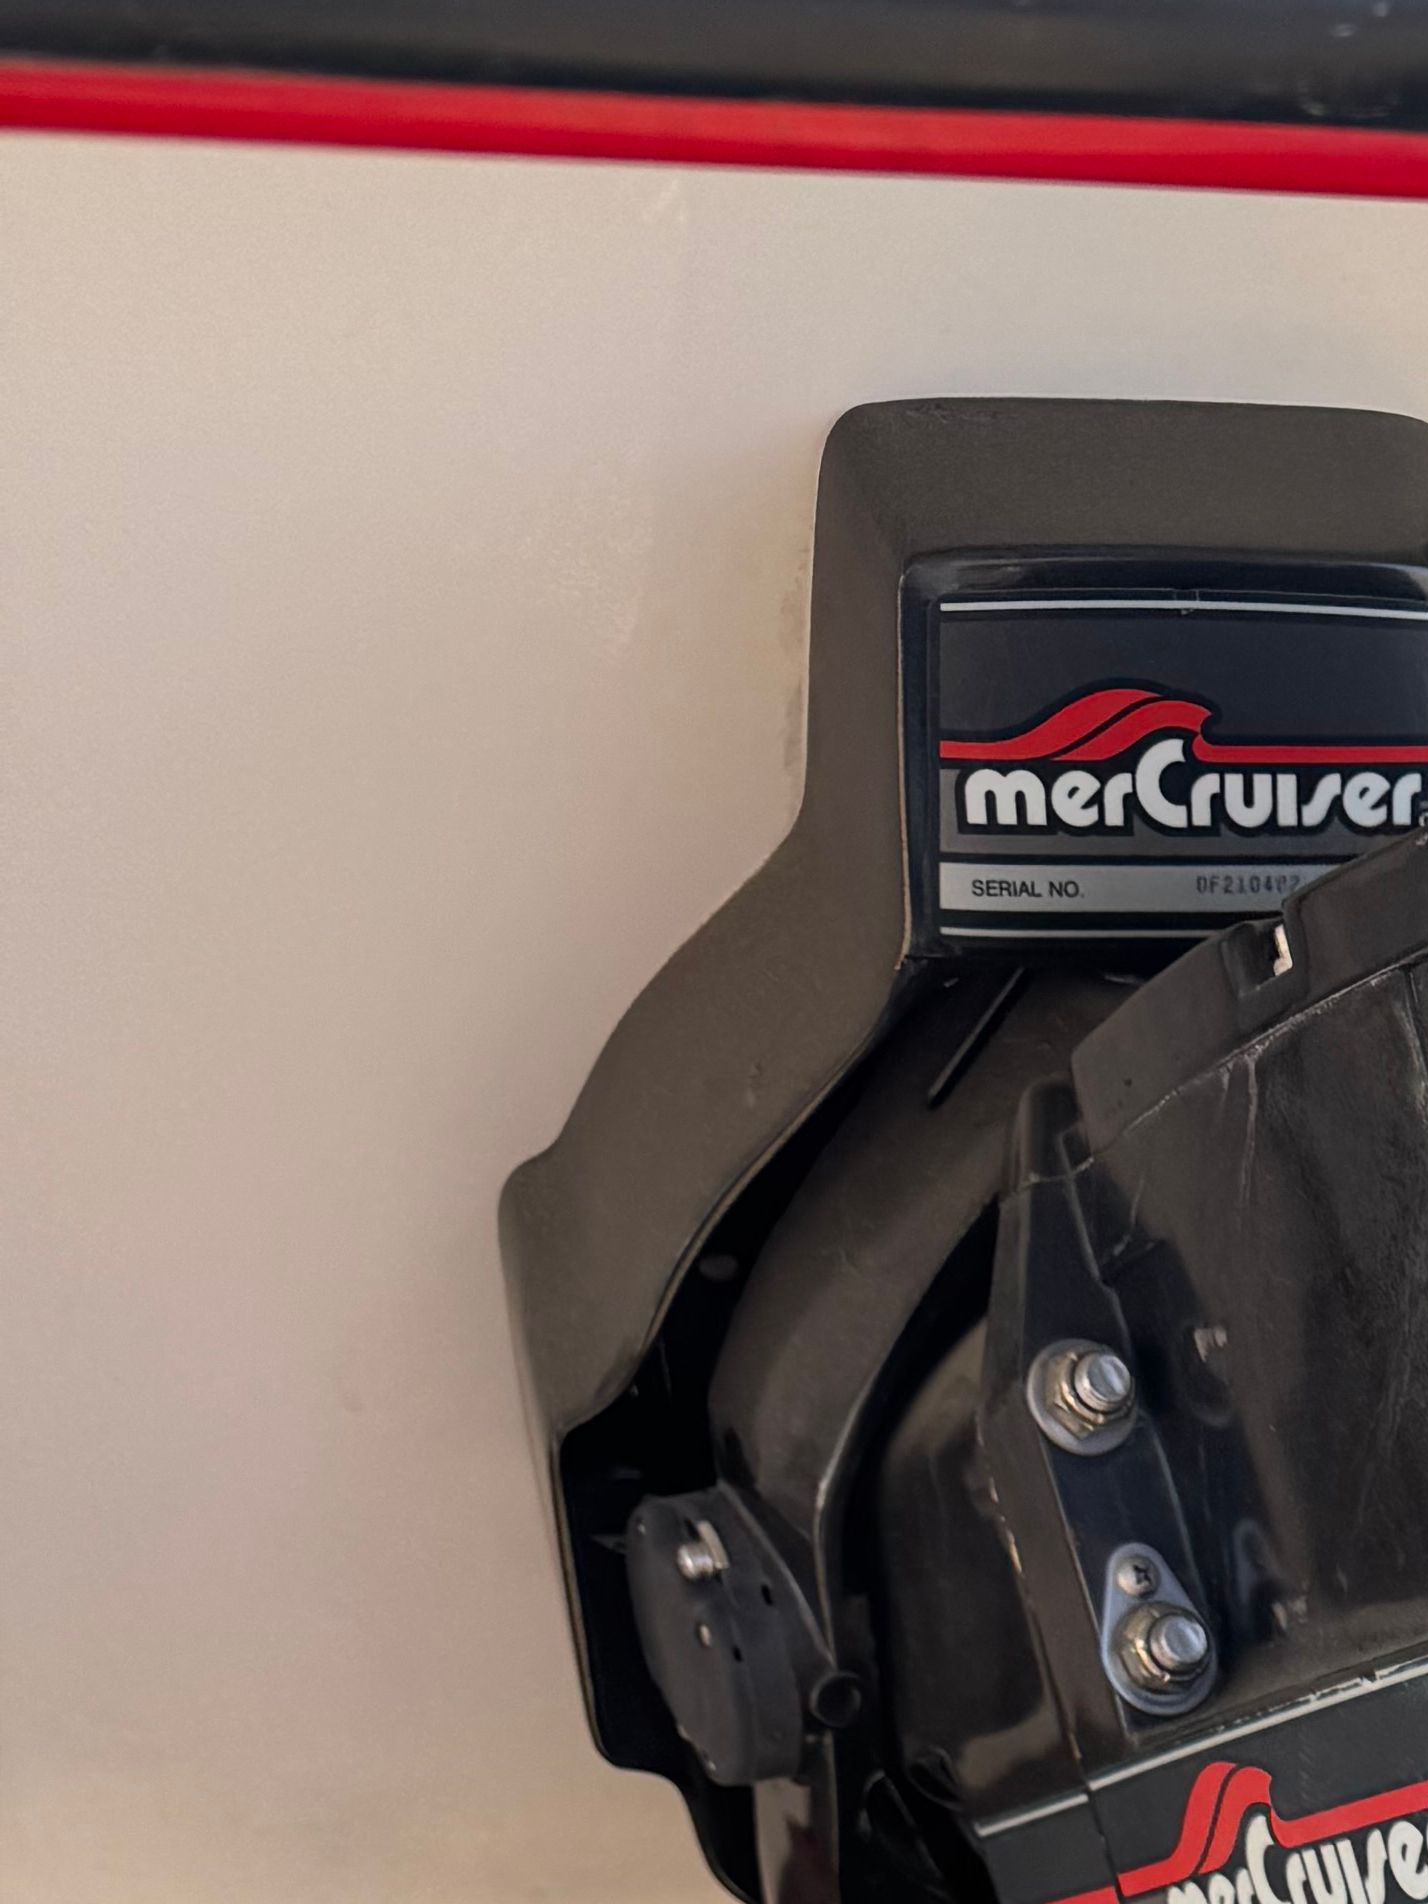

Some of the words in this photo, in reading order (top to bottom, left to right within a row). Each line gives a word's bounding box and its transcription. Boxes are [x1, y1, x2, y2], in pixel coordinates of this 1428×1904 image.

[964, 738, 1422, 829] merCruiser
[971, 879, 1043, 898] SERIAL
[1048, 880, 1085, 898] NO.
